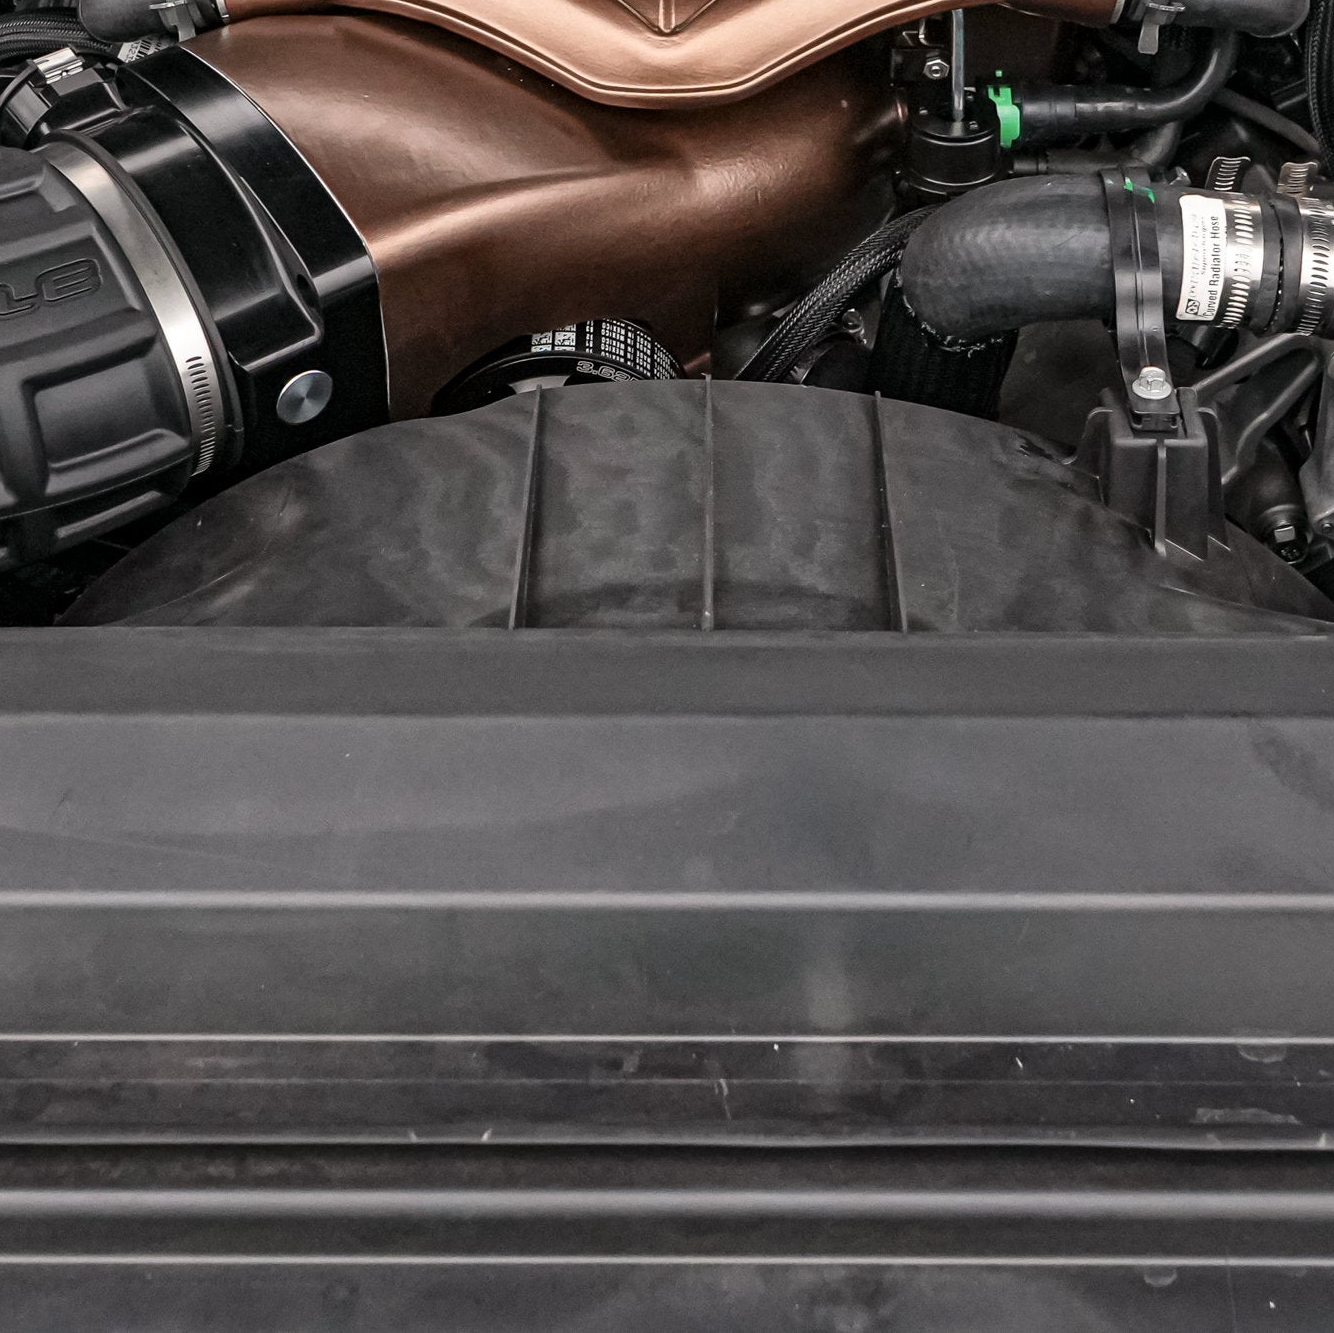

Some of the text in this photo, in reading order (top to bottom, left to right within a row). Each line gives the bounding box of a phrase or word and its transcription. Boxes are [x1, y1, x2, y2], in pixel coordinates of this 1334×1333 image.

[1205, 216, 1222, 318] Curved Radiator Hose
